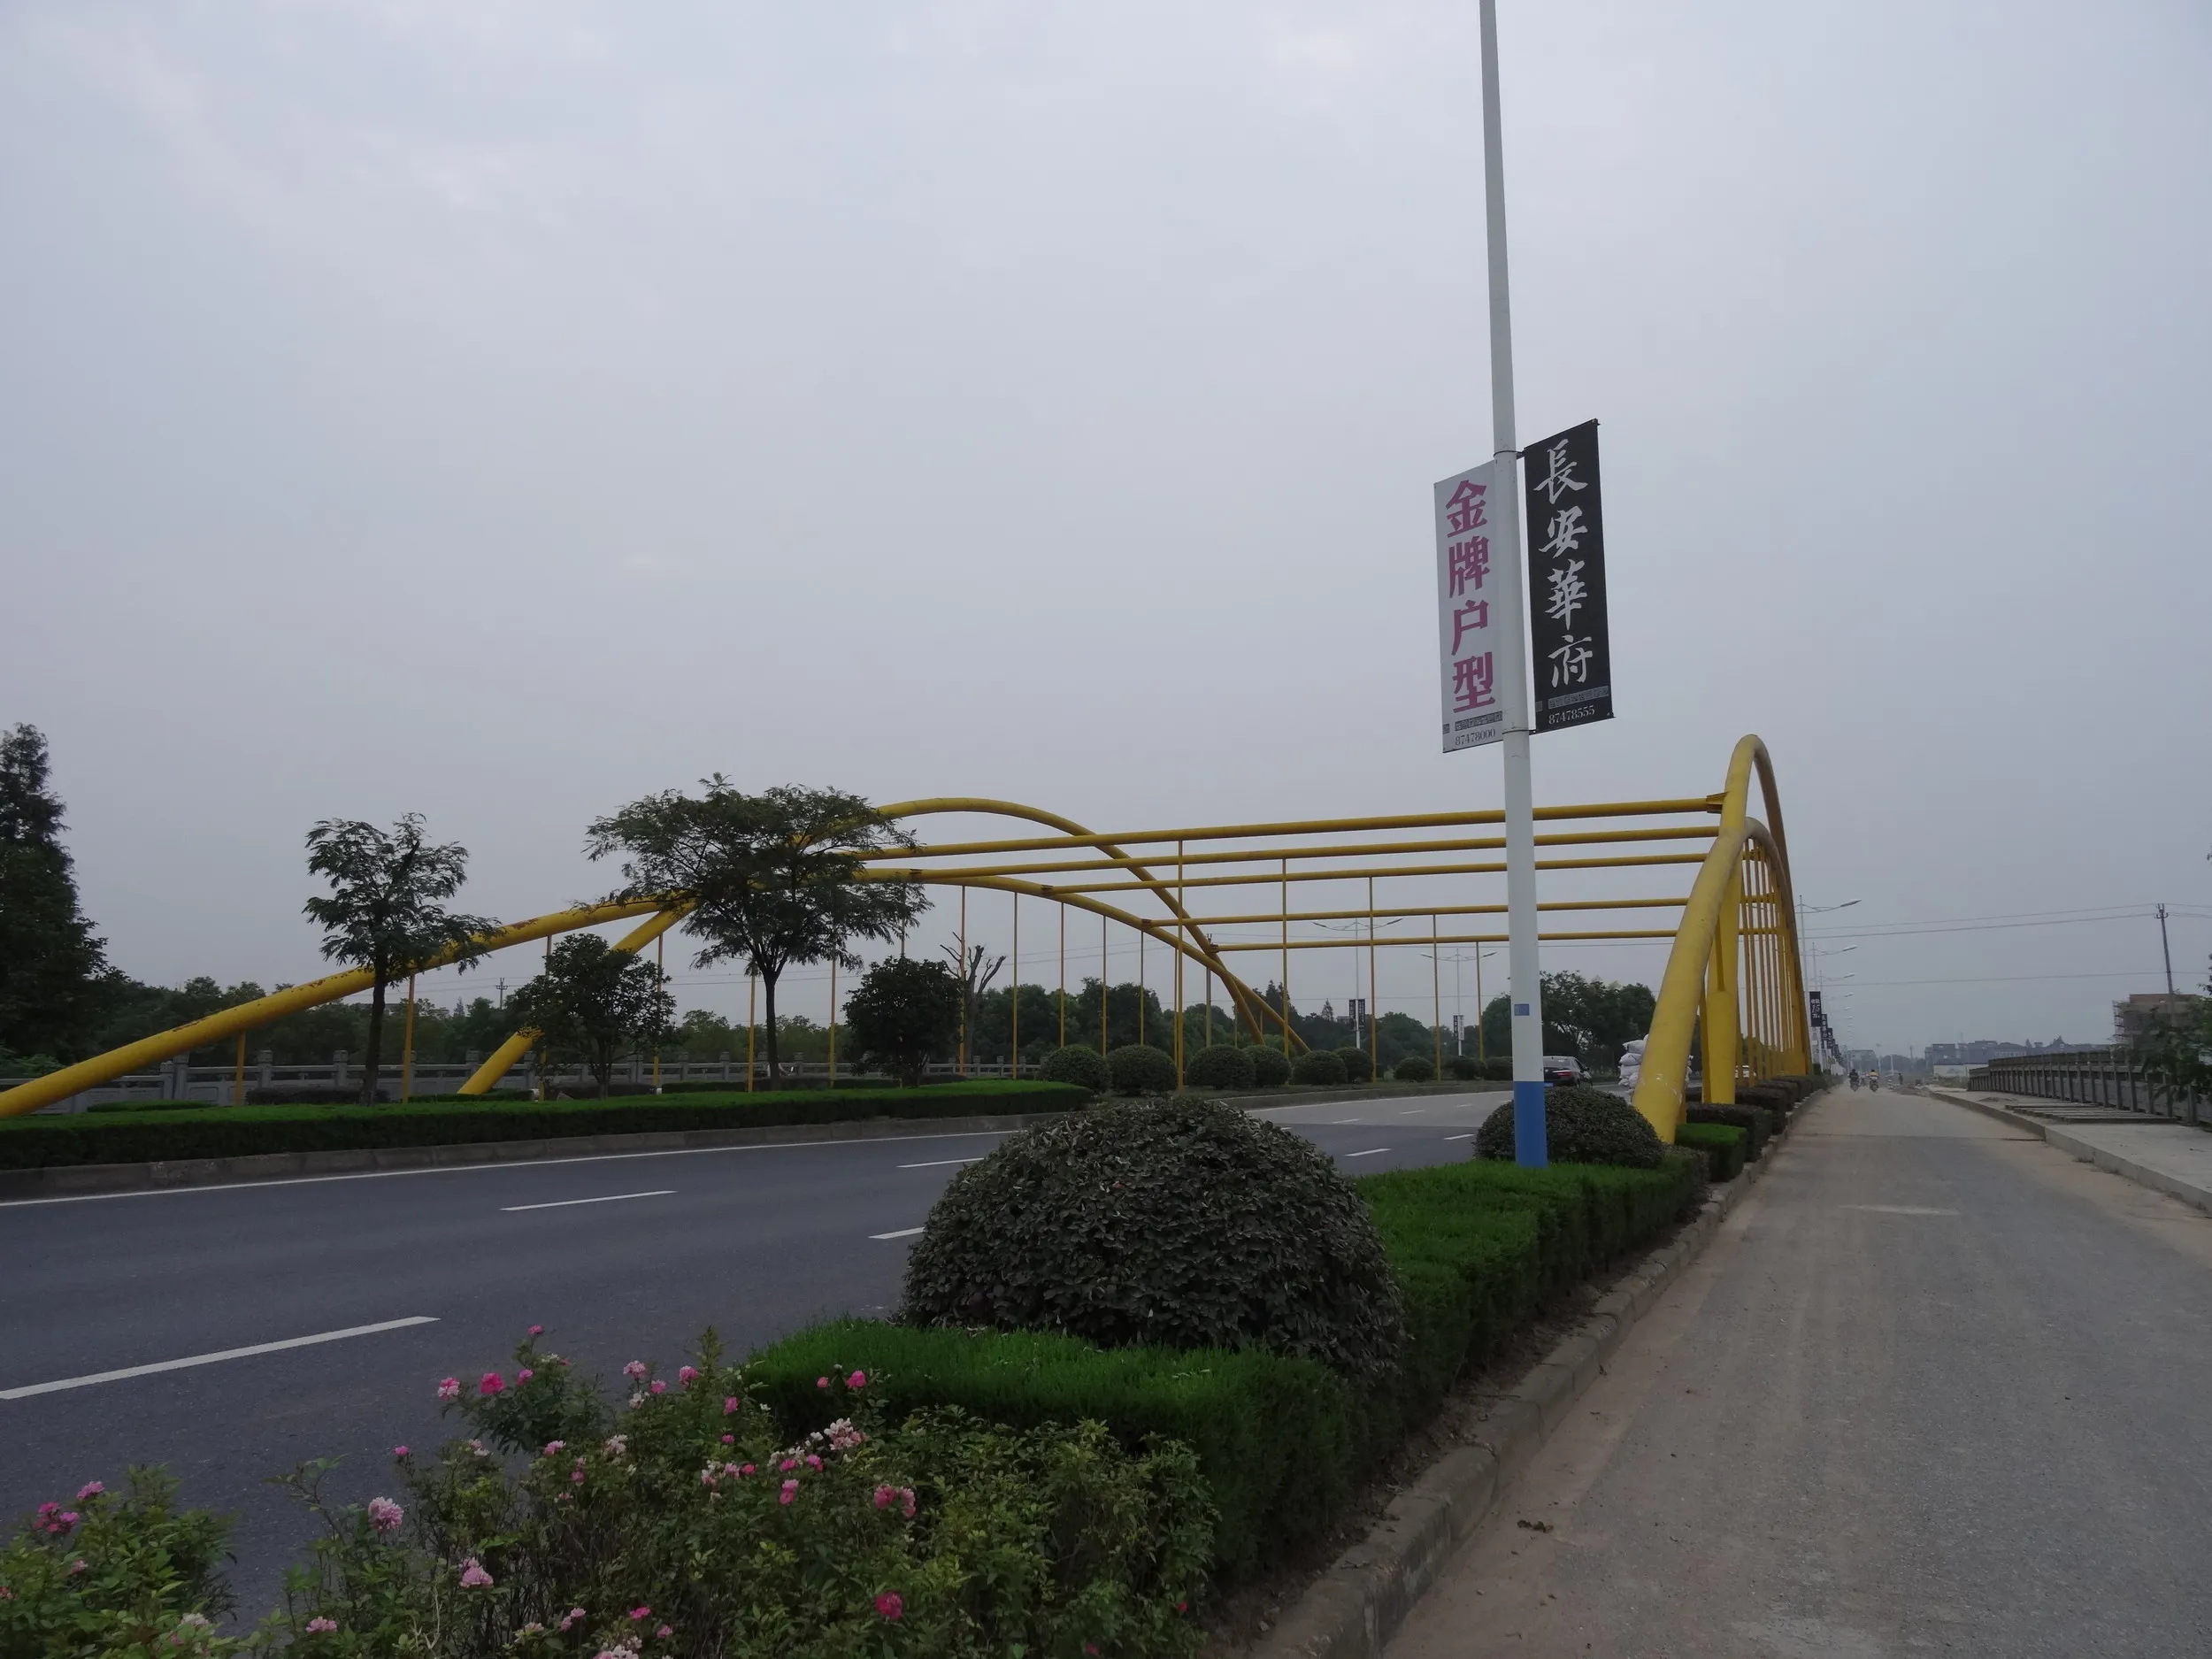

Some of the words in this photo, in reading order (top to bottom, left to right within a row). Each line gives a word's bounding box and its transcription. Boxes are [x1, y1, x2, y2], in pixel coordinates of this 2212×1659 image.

[1445, 480, 1495, 713] 金牌户型
[1534, 439, 1593, 687] 長安華府
[1455, 728, 1496, 746] 87478000
[1548, 705, 1595, 725] 87478555
